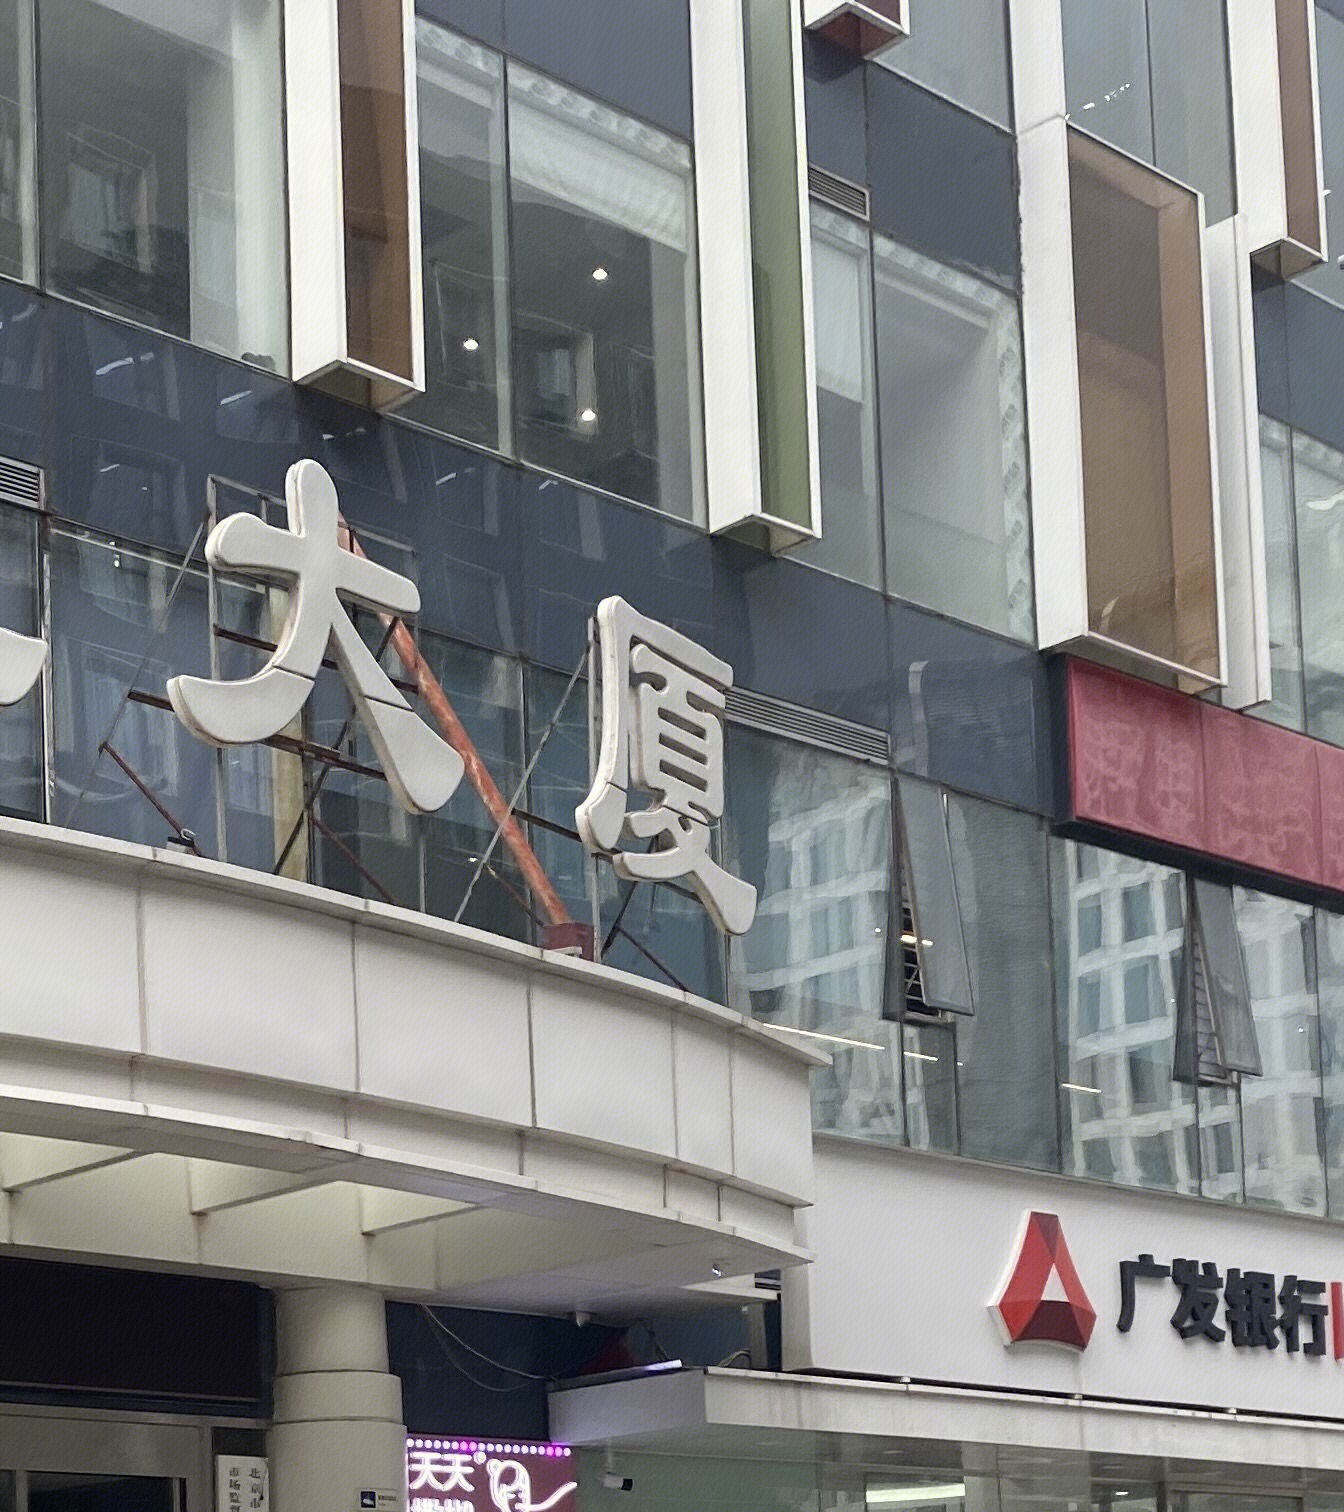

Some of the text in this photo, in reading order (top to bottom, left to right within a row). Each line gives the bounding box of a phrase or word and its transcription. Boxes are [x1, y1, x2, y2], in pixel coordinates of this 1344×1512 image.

[1116, 1253, 1329, 1357] 广发银行
[410, 1451, 475, 1493] 天天
